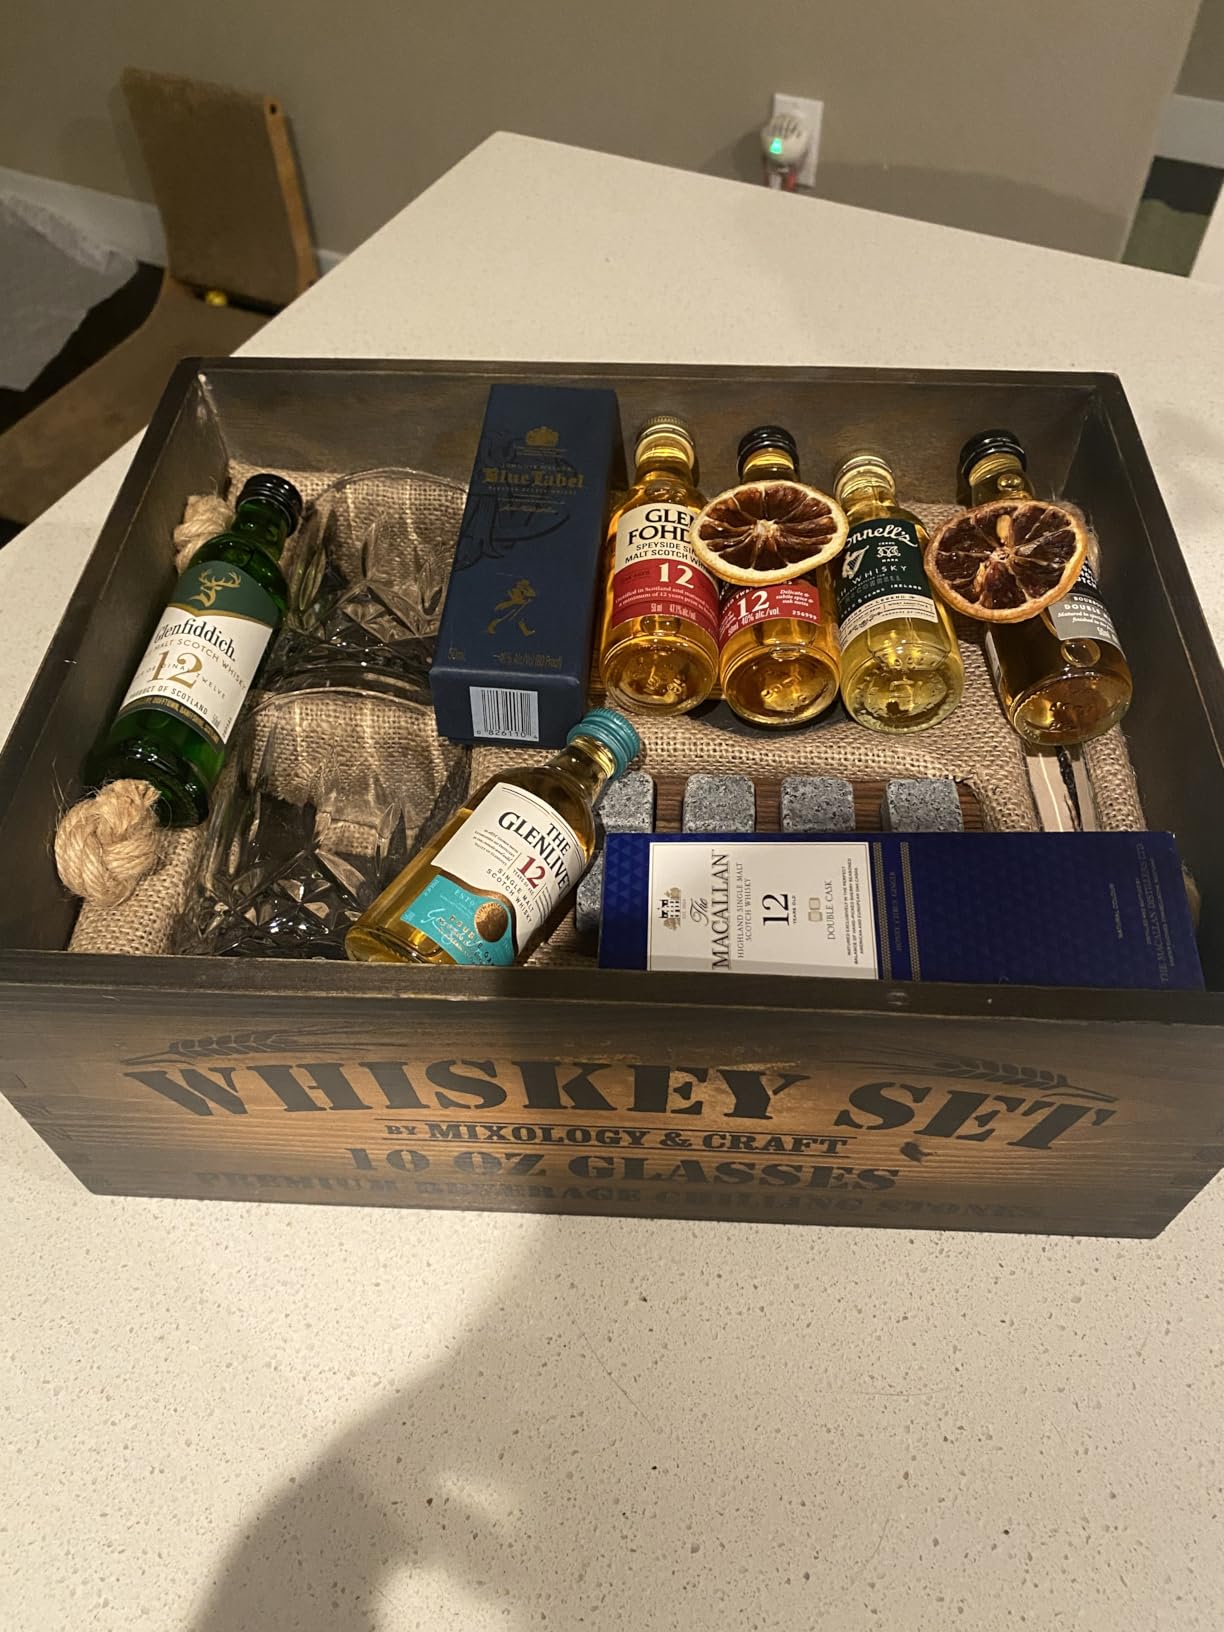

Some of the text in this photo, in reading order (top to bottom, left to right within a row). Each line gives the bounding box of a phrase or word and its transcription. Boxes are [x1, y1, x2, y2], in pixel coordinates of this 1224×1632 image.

[482, 467, 584, 488] Blue Label
[636, 541, 681, 551] SPEYSIDE
[846, 525, 918, 548] onnell's
[625, 550, 649, 564] MALT
[651, 549, 688, 561] SCOTCH
[659, 562, 694, 590] 12
[852, 565, 907, 585] WHISKY
[737, 591, 770, 620] 12
[1064, 604, 1101, 615] DOUBLE
[147, 650, 203, 689] 12
[177, 638, 219, 662] SCOTCH
[222, 660, 247, 690] WHISKY
[171, 688, 208, 715] SCOTLAND
[546, 823, 571, 856] THE
[516, 855, 546, 889] 12
[486, 868, 515, 896] SCOTCH
[515, 897, 533, 923] WHISKY
[497, 868, 535, 912] SINGLE MALT
[689, 897, 709, 927] The
[711, 853, 730, 970] MACALLAN
[735, 862, 744, 959] HIGHLAND SINGLE MALT
[743, 877, 752, 941] SCOTCH WHISKY
[761, 892, 789, 926] 12
[824, 880, 836, 940] DOUBLE CASK
[124, 1060, 1117, 1149] WHISKEY SET
[386, 1122, 848, 1156] BY MIXOLOGY & CRAFT
[346, 1148, 900, 1191] 10 OZ GLASSES
